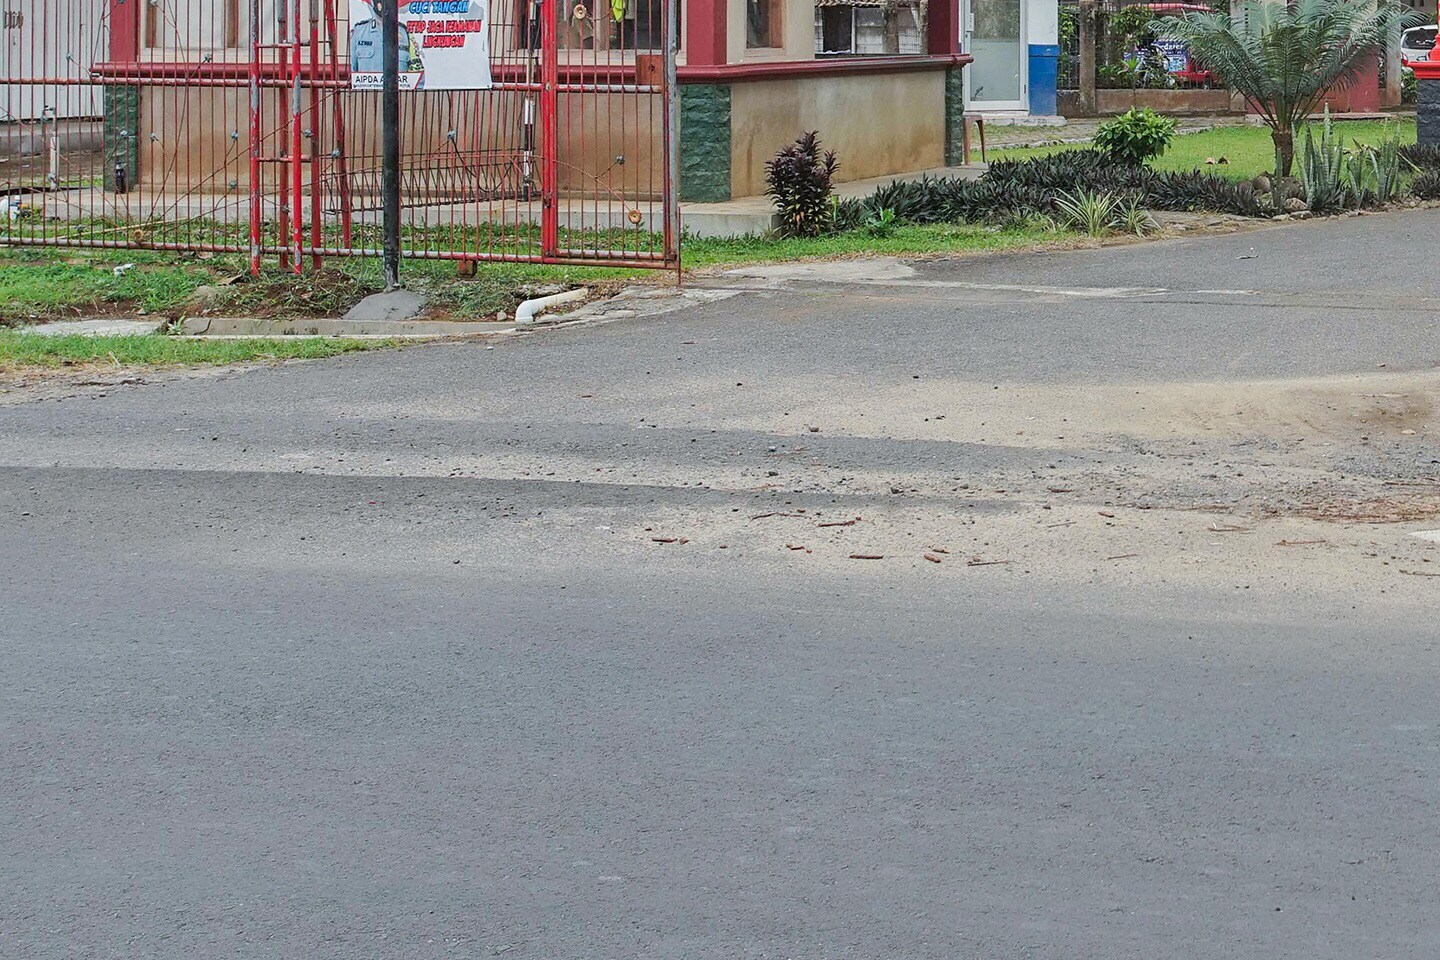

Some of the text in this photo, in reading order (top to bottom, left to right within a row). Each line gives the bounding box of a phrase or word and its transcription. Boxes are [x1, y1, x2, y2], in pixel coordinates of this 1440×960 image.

[408, 0, 470, 14] CUCI TANGAN
[355, 75, 379, 83] AIPDA
